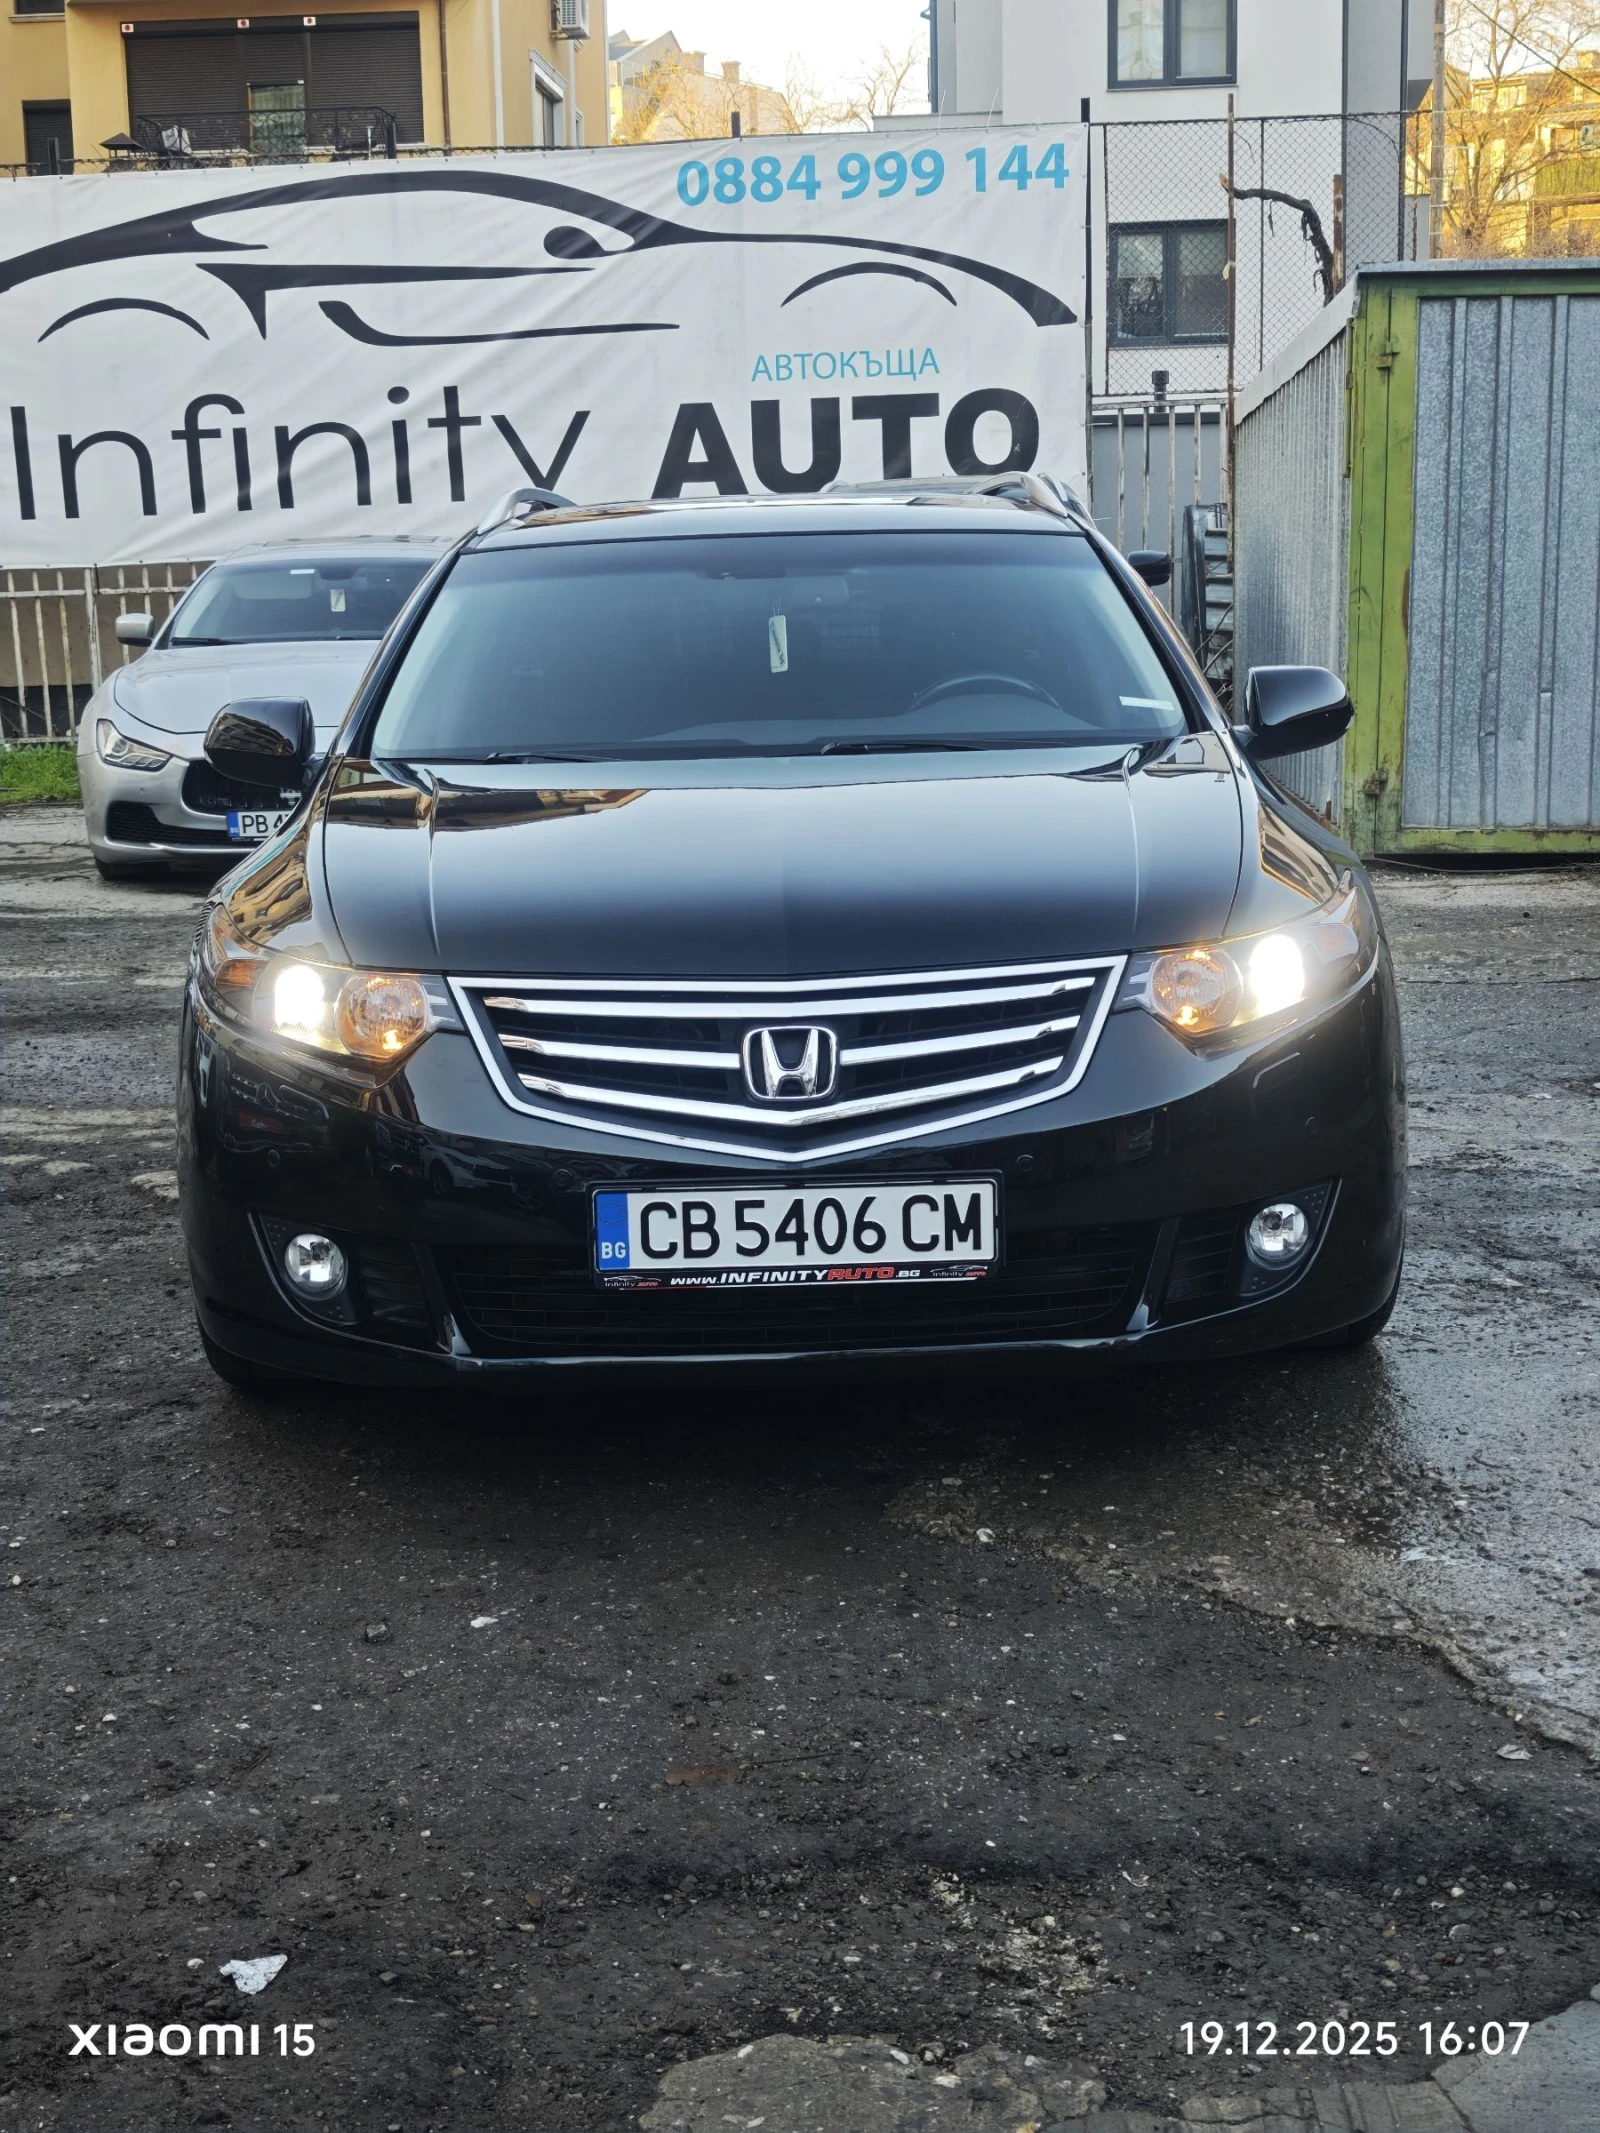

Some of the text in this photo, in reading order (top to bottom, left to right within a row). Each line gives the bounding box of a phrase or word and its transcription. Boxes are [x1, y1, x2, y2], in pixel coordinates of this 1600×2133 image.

[677, 143, 1070, 206] 0884 999 144
[751, 347, 940, 382] АВТОКЪЩА
[10, 386, 1040, 520] Infinity AUTO
[241, 814, 269, 834] PB
[640, 1192, 982, 1259] CB 5406 CM
[601, 1241, 627, 1260] BG
